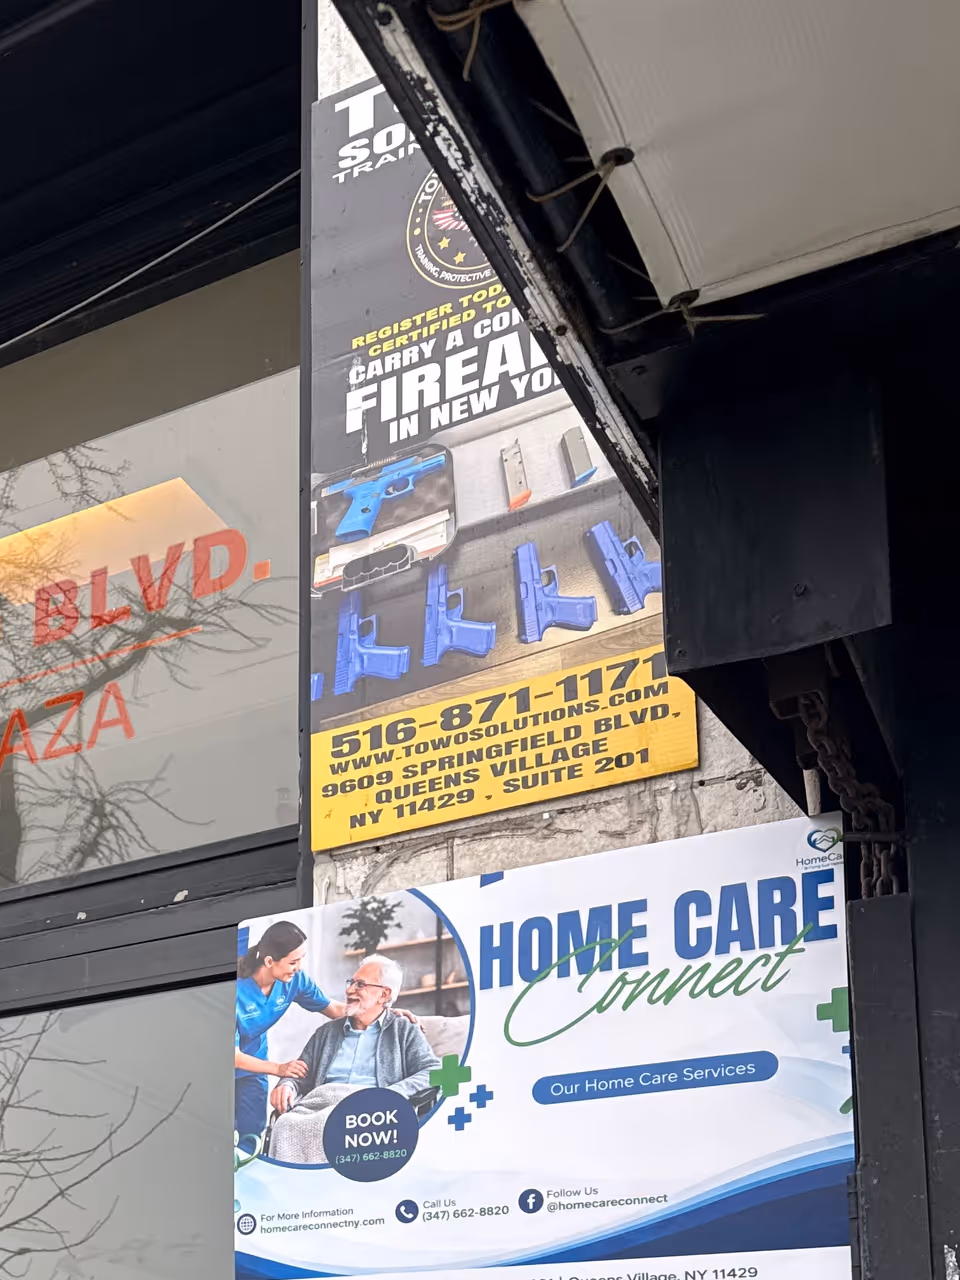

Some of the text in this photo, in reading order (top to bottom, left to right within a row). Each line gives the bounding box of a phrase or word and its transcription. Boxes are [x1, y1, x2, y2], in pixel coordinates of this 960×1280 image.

[334, 83, 399, 138] T
[338, 122, 416, 169] SO
[415, 243, 492, 283] TRAINING, PROTECTIVE
[351, 283, 507, 350] REGISTER TOD
[368, 295, 512, 357] CERTIFIED TO
[349, 338, 437, 385] CARRY
[445, 328, 465, 352] A
[389, 413, 419, 444] IN
[430, 384, 500, 430] NEW
[31, 527, 272, 648] BLVD.
[329, 681, 669, 776] WWW.TOWOSOLUTIONS.COM
[330, 651, 669, 759] 516-871-1171
[321, 770, 393, 798] 9609
[402, 724, 582, 779] SPRINGFIELD
[375, 737, 609, 805] QUEENS VILLAGE
[349, 808, 384, 829] NY
[392, 788, 475, 819] 11429
[503, 763, 584, 794] SUITE
[594, 747, 650, 774] 201
[479, 868, 838, 991] HOME CARE
[503, 921, 815, 1047] Connect
[550, 1062, 756, 1096] Our Home Care Services
[344, 1129, 398, 1149] NOW!
[345, 1109, 399, 1129] BOOK
[335, 1149, 407, 1165] (347) 662-8820
[260, 1207, 354, 1222] For More Information
[422, 1198, 457, 1209] Call Us
[422, 1205, 510, 1223] (347) 662-8820
[546, 1186, 599, 1199] Follow Us
[546, 1194, 668, 1213] @homecareconnect
[260, 1216, 385, 1234] homecareconnectny.com
[684, 1270, 708, 1280] NY
[712, 1266, 759, 1280] 11429
